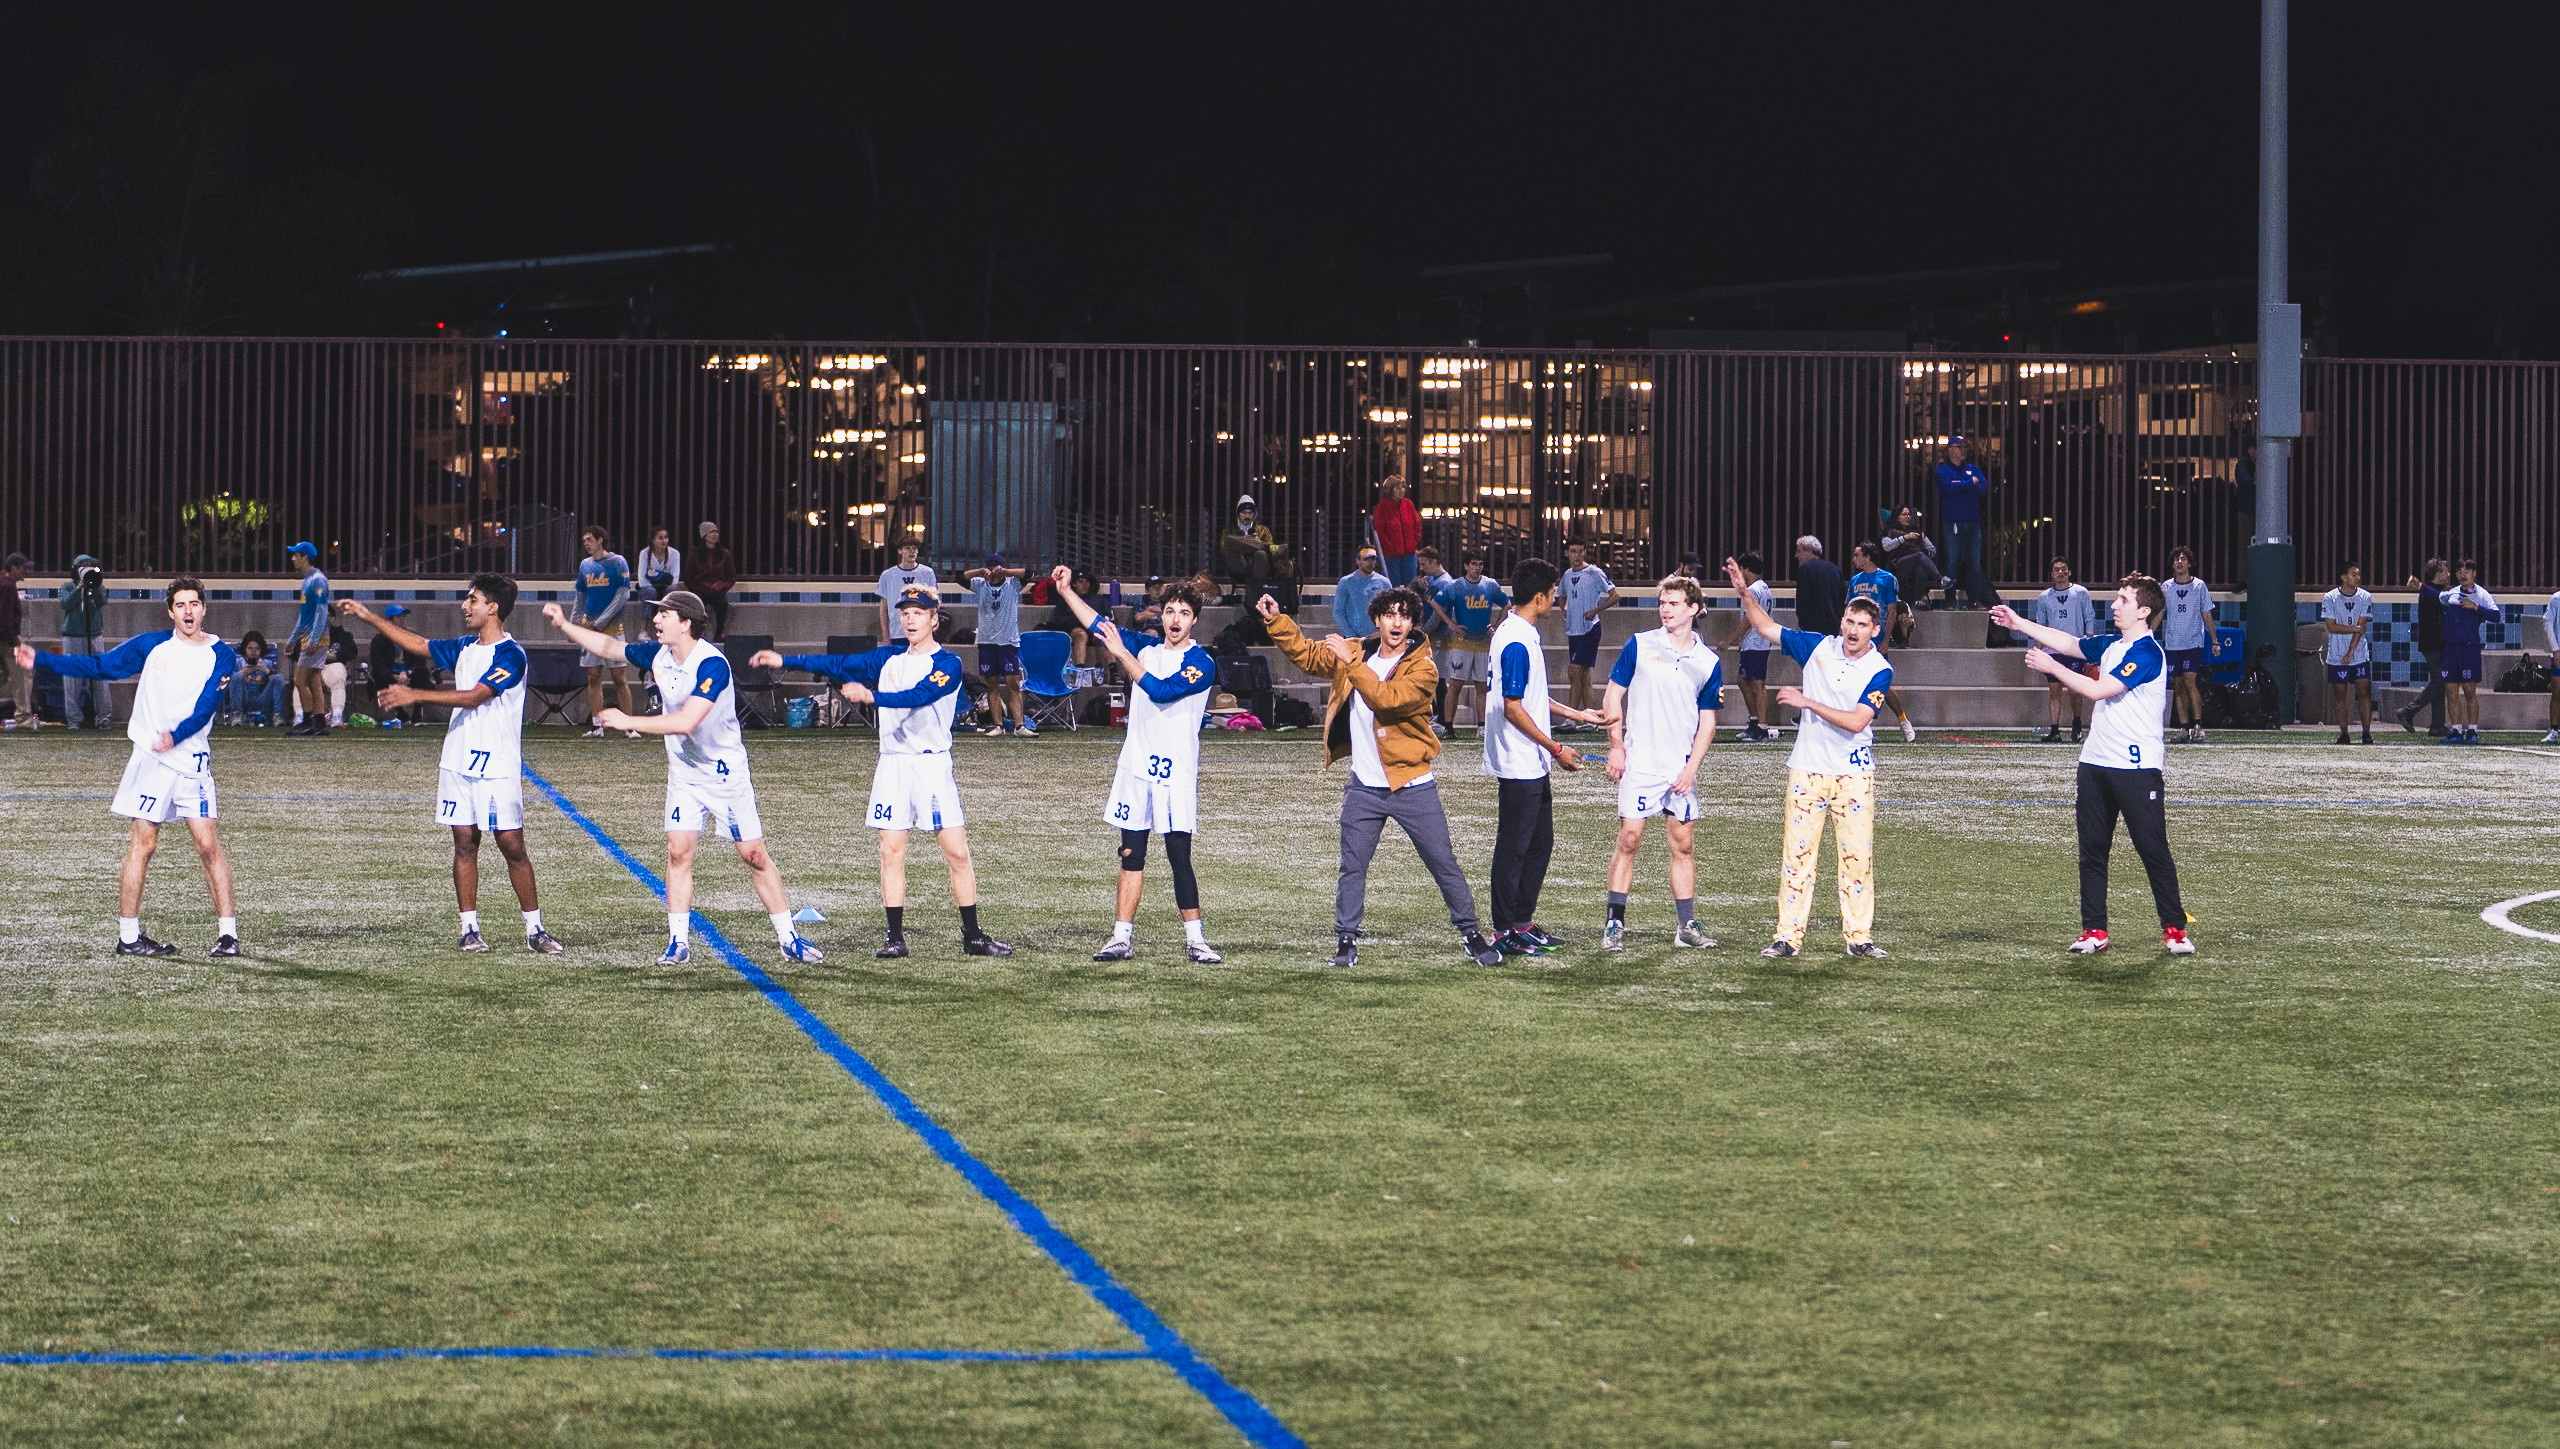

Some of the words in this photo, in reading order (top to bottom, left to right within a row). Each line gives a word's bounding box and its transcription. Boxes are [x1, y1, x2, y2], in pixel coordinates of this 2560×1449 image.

[1853, 582, 1878, 594] UCLA
[1464, 594, 1489, 609] Ucla
[2177, 604, 2187, 613] 86
[2058, 609, 2068, 619] 39
[486, 667, 512, 684] 77
[2120, 662, 2138, 677] 9
[2356, 667, 2366, 677] 34
[1867, 690, 1885, 709] 43
[468, 749, 491, 773] 77
[1849, 746, 1870, 767] 43
[2128, 744, 2141, 764] 9
[716, 758, 730, 775] 4
[1147, 754, 1173, 779] 33
[138, 794, 157, 813] 77
[442, 799, 457, 818] 77
[874, 803, 893, 821] 84
[1114, 801, 1130, 822] 33
[1637, 795, 1647, 812] 5
[671, 806, 681, 823] 4
